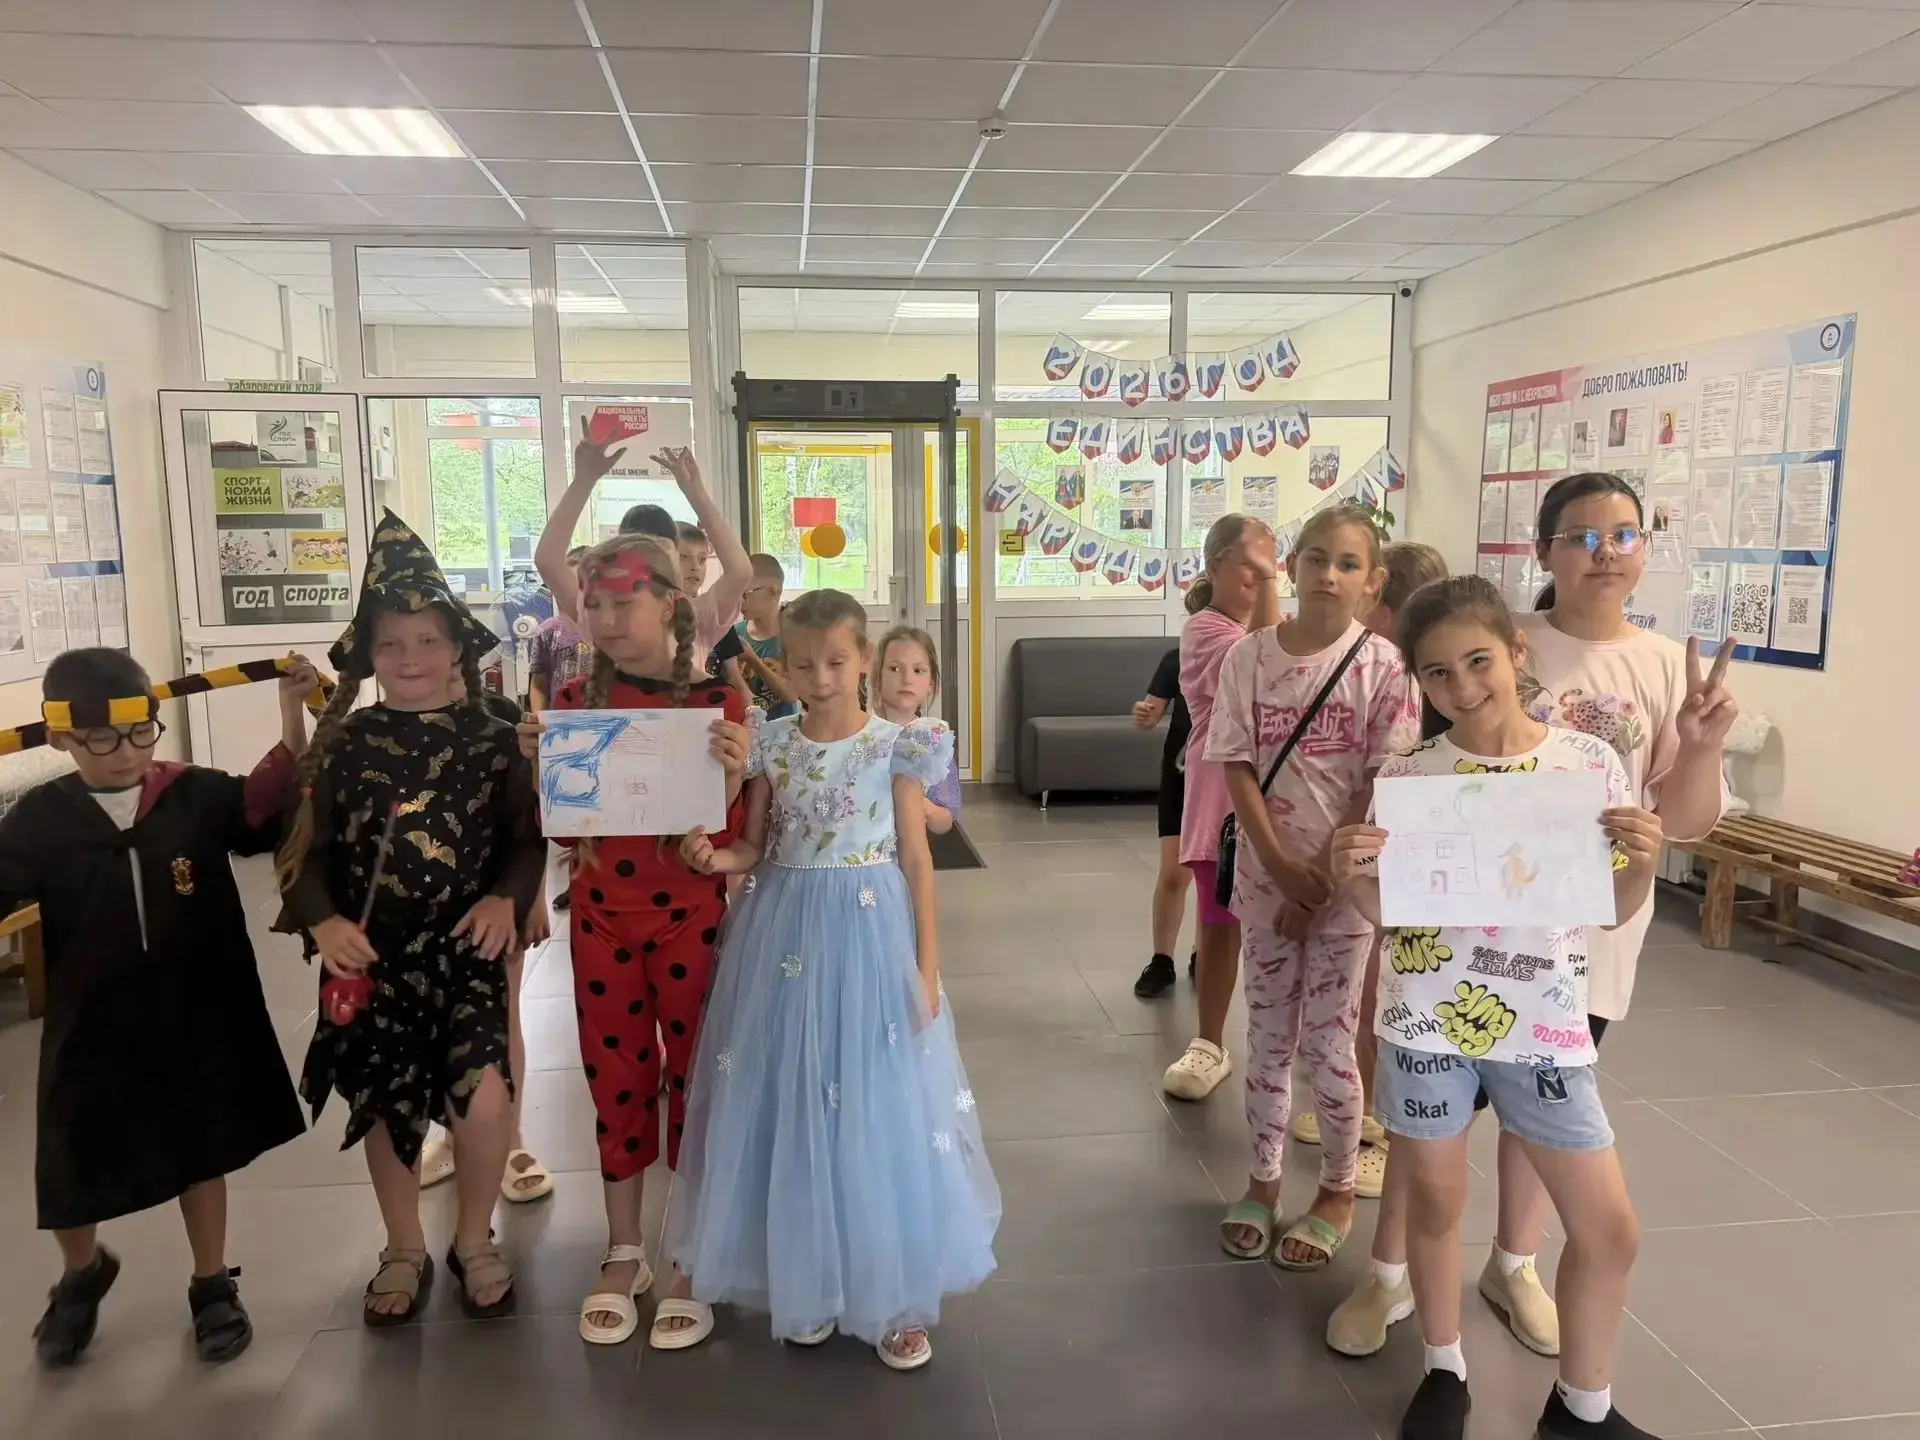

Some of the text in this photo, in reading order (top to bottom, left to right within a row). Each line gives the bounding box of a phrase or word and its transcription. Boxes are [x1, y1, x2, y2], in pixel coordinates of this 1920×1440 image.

[1046, 338, 1301, 399] 2026 ГОД
[1582, 361, 1689, 399] ДОБРО ПОЖАЛОВАТЬ!
[597, 406, 648, 415] НАЦИОНАЛЬНЫЕ
[619, 414, 648, 422] ПРОЕКТЫ
[624, 422, 648, 430] РОССИИ
[1049, 407, 1309, 456] ЕДИНСТВА
[611, 468, 627, 476] ВАШЕ
[224, 487, 271, 496] НОРМА
[226, 497, 272, 506] ЖИЗНИ
[235, 587, 350, 608] год спорта
[1472, 946, 1555, 970] SUNNY DAYS
[1568, 954, 1587, 963] FUN
[1467, 956, 1535, 982] SWEET
[1381, 999, 1413, 1026] MOOD
[1404, 1098, 1449, 1119] Skat
